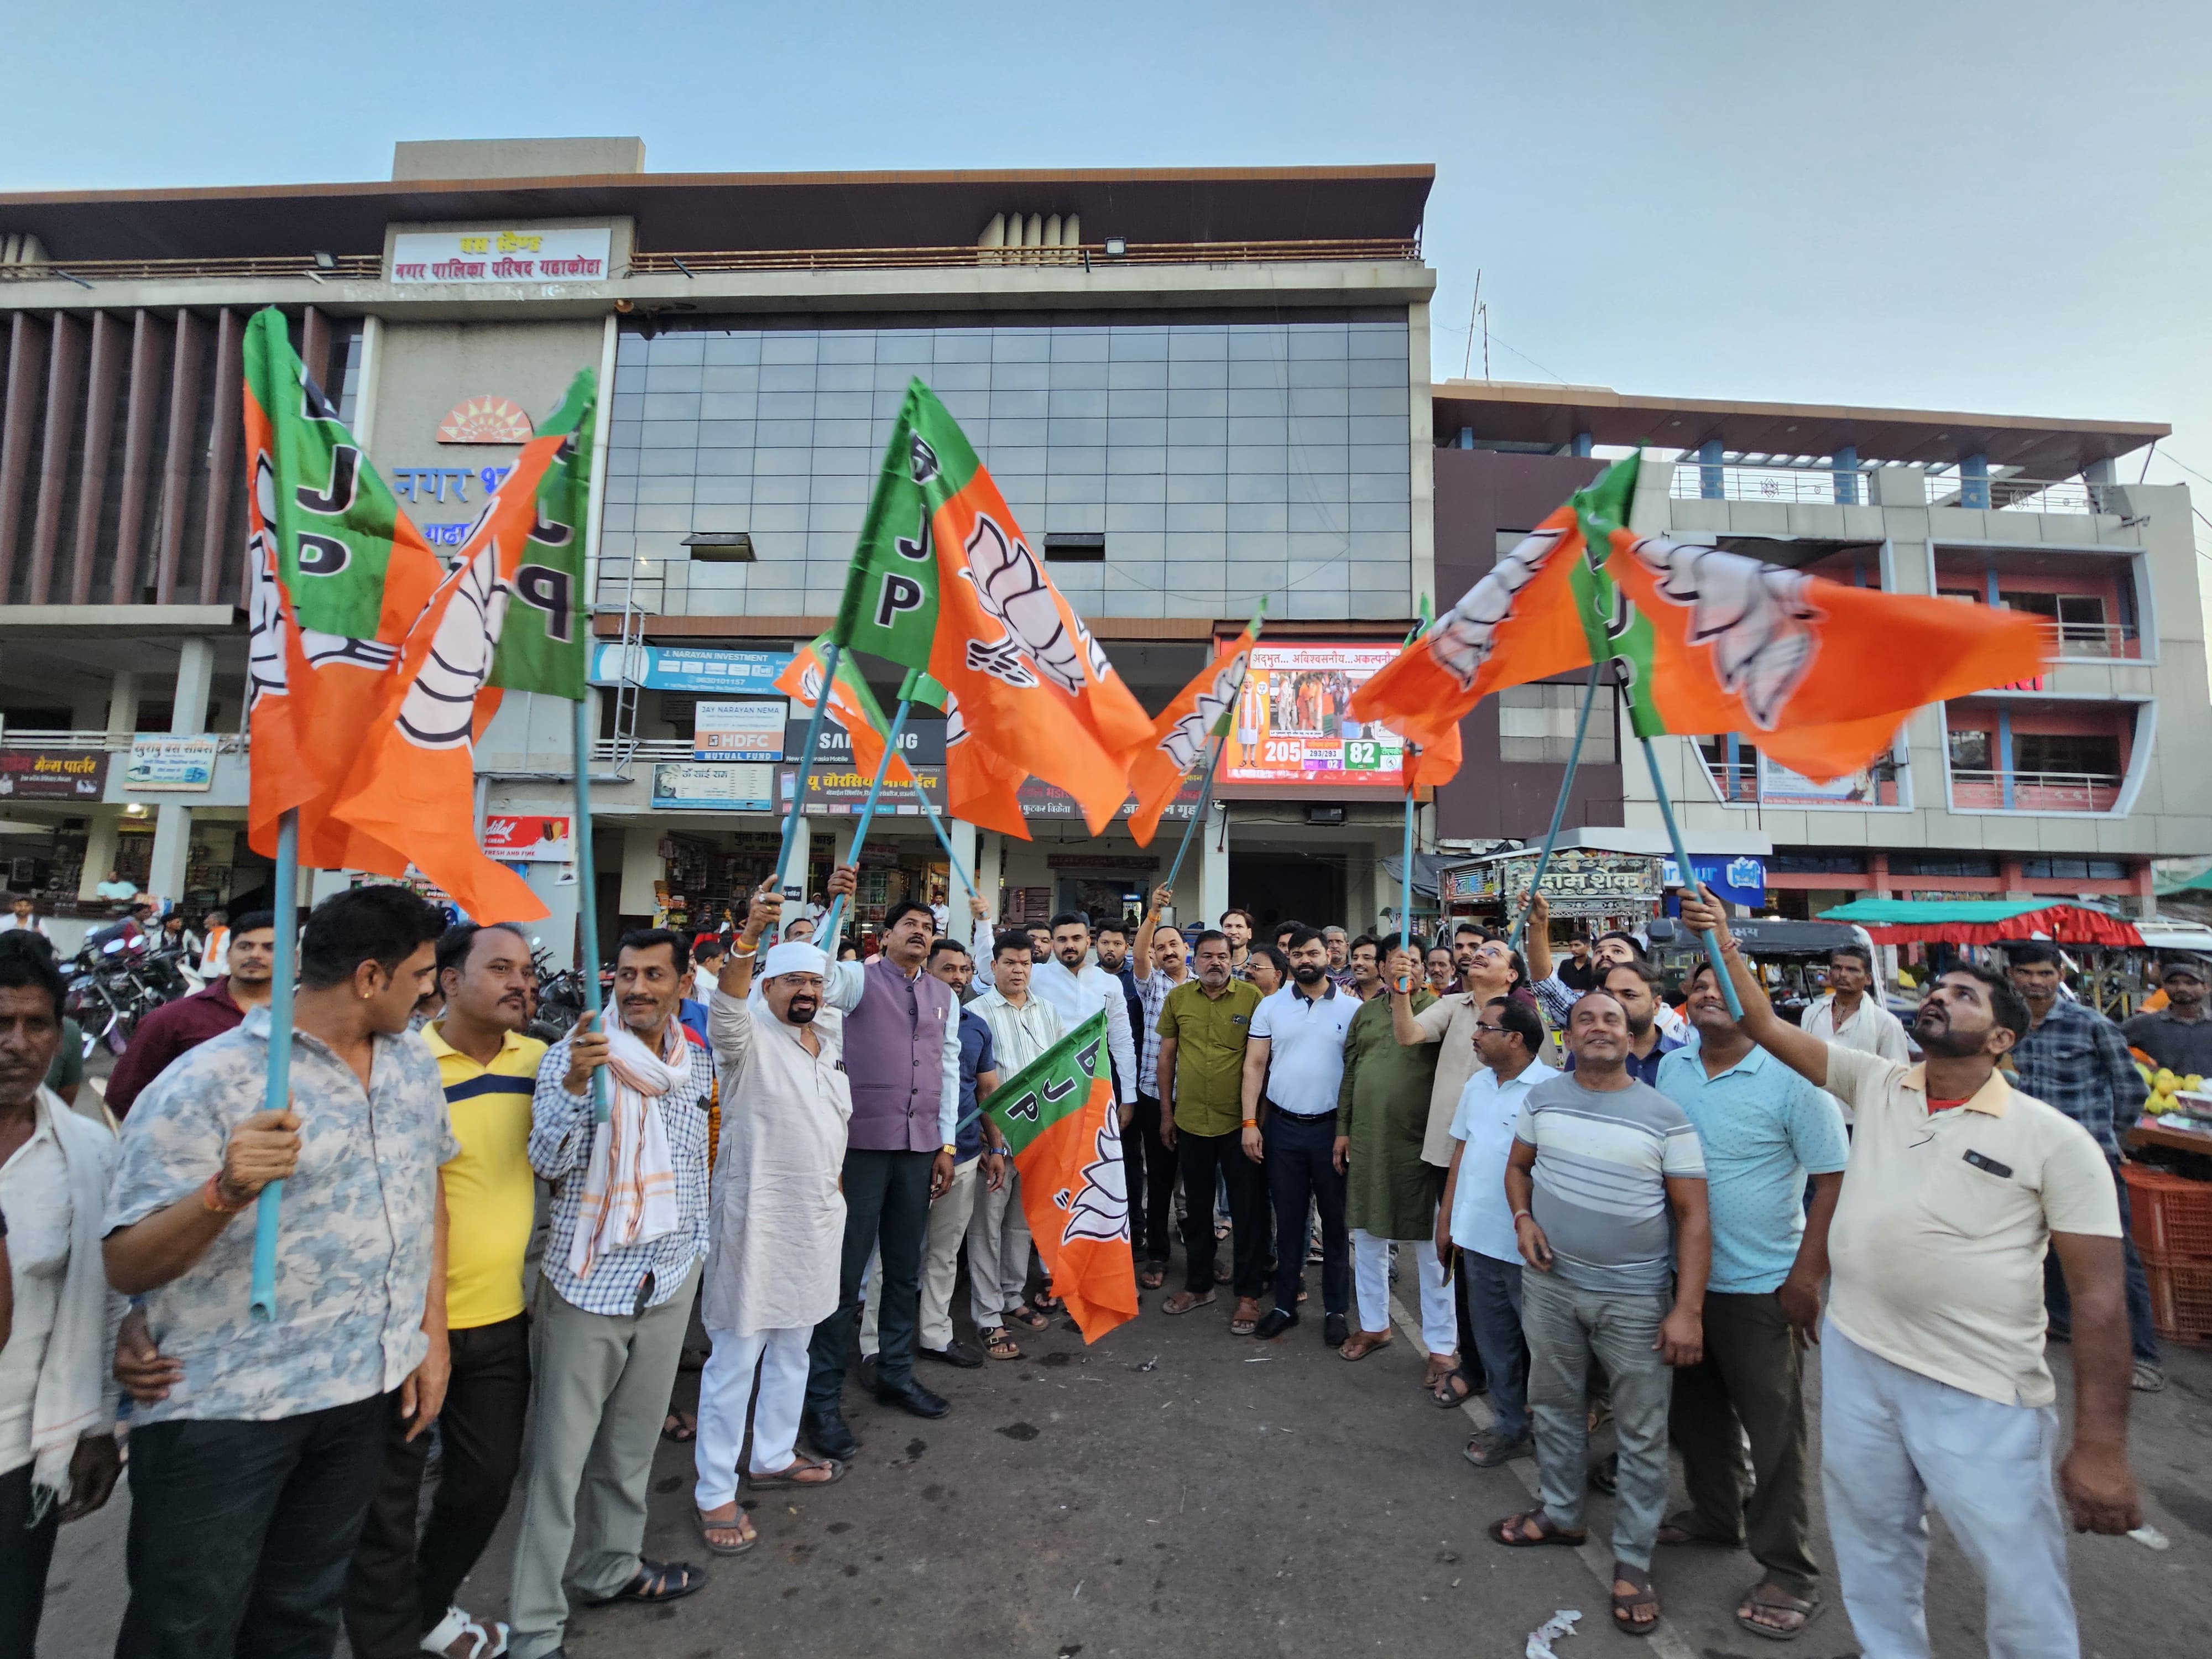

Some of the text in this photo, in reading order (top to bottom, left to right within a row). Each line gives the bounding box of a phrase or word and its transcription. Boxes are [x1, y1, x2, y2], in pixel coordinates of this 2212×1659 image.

[396, 264, 426, 278] नगर
[432, 258, 486, 278] पालिका
[492, 257, 534, 277] परिषद
[393, 468, 474, 503] नगर
[672, 650, 712, 659] NARAYAN
[714, 652, 768, 662] INVESTMENT
[722, 734, 769, 747] HDFC
[1265, 742, 1301, 761] 205
[1349, 742, 1374, 763] 82
[823, 773, 873, 788] चौरसिय
[1589, 867, 1640, 889] शेक
